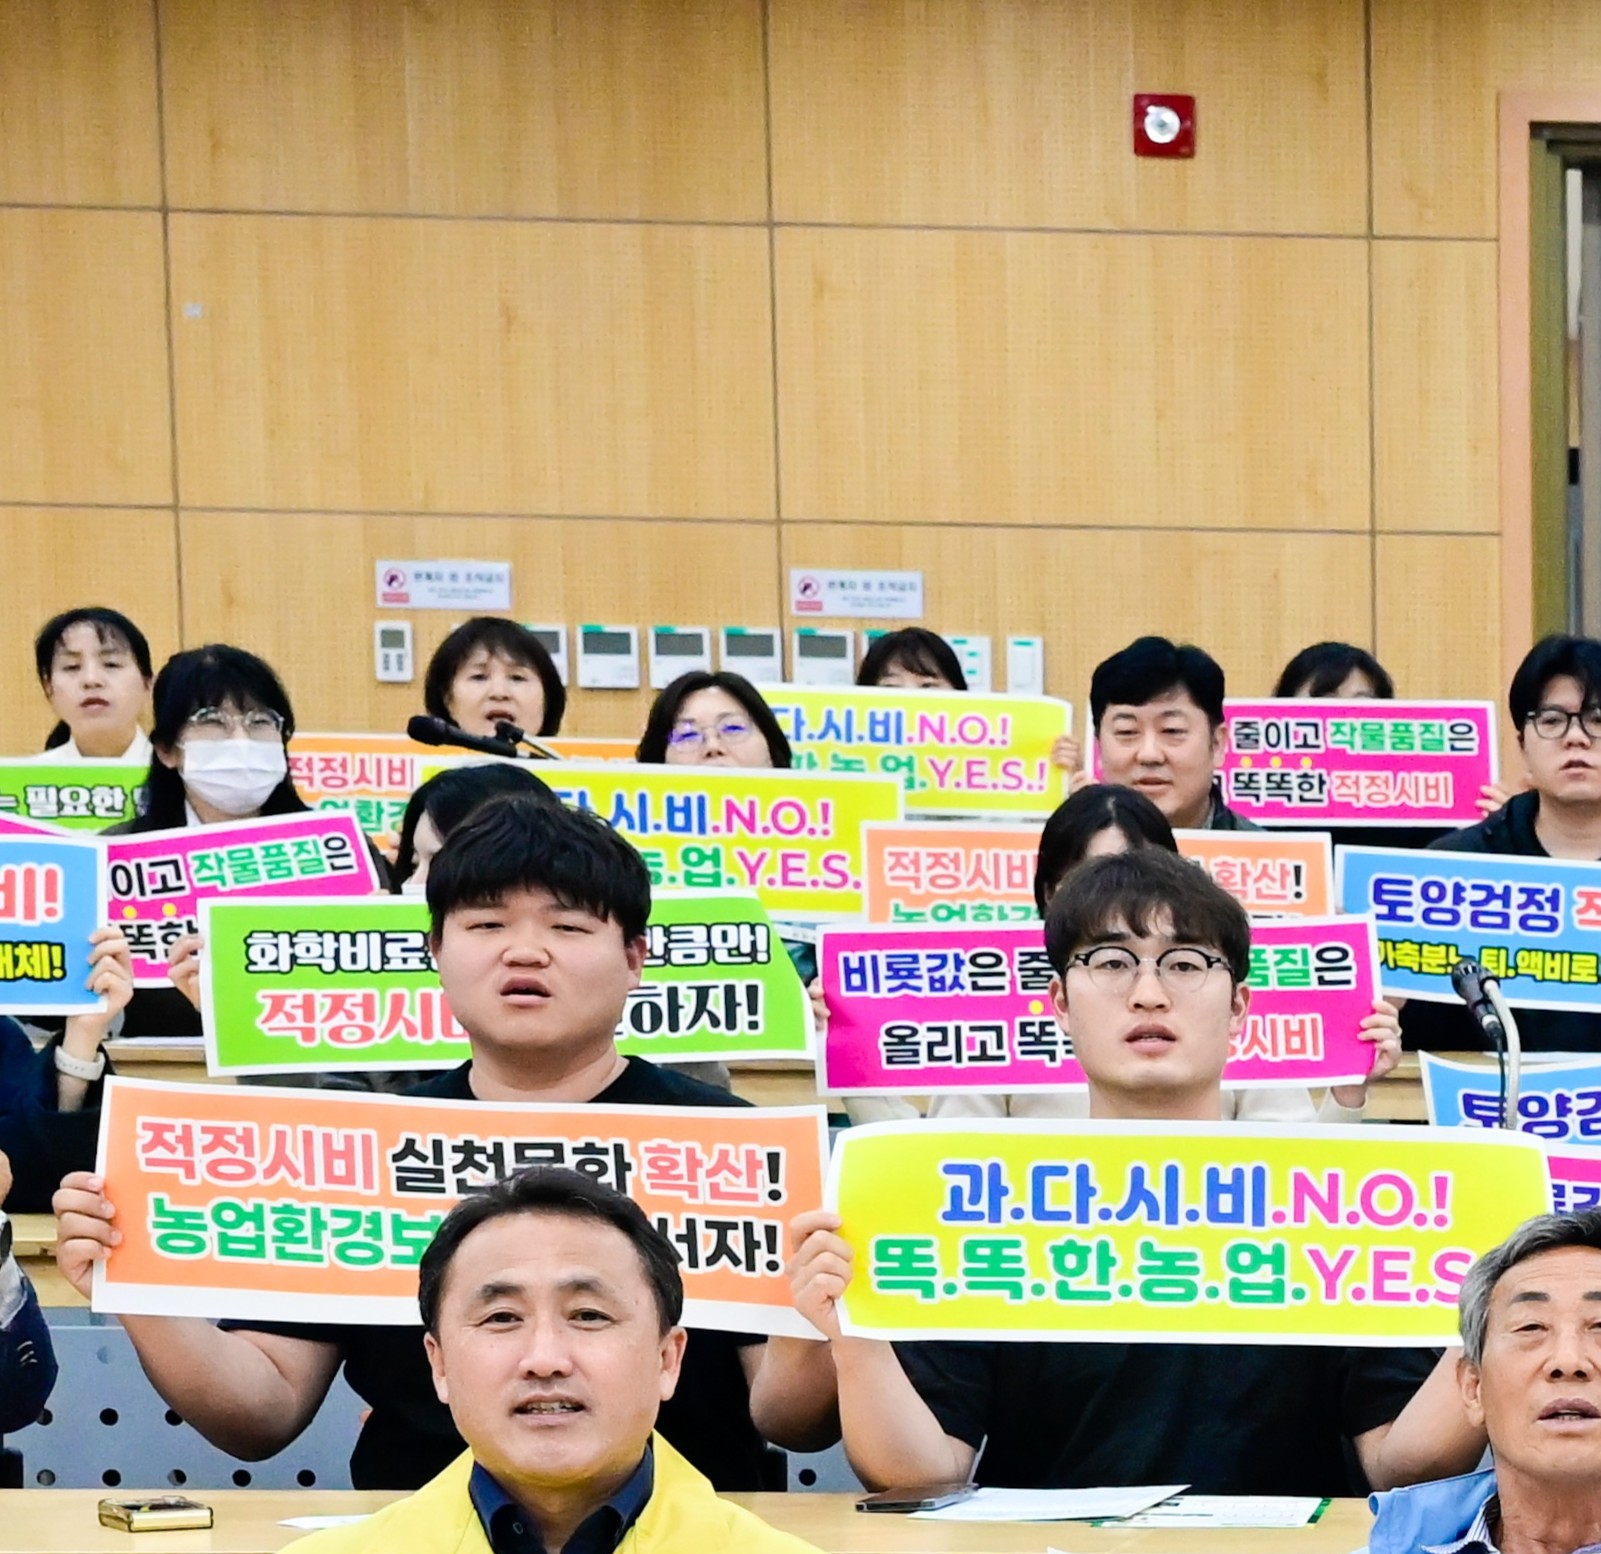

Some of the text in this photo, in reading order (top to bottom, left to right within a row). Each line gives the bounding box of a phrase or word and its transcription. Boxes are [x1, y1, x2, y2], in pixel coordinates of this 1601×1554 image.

[1234, 722, 1476, 752] 줄이고 작물품질은
[28, 786, 124, 817] 필요한
[1232, 771, 1326, 804] 똑똑한
[1334, 773, 1450, 805] 적정시비
[108, 857, 184, 899] 이고
[192, 836, 354, 888] 작물품질은
[1218, 859, 1303, 900] 확산!
[1373, 877, 1561, 934] 토양검정
[246, 931, 439, 974] 화학비료
[840, 950, 1008, 995] 비룟값은
[881, 1022, 1005, 1065] 올리고
[139, 1120, 377, 1192] 적정시비
[642, 1142, 784, 1203] 확산!
[940, 1163, 1452, 1228] 과.다.시.비.N.O.!
